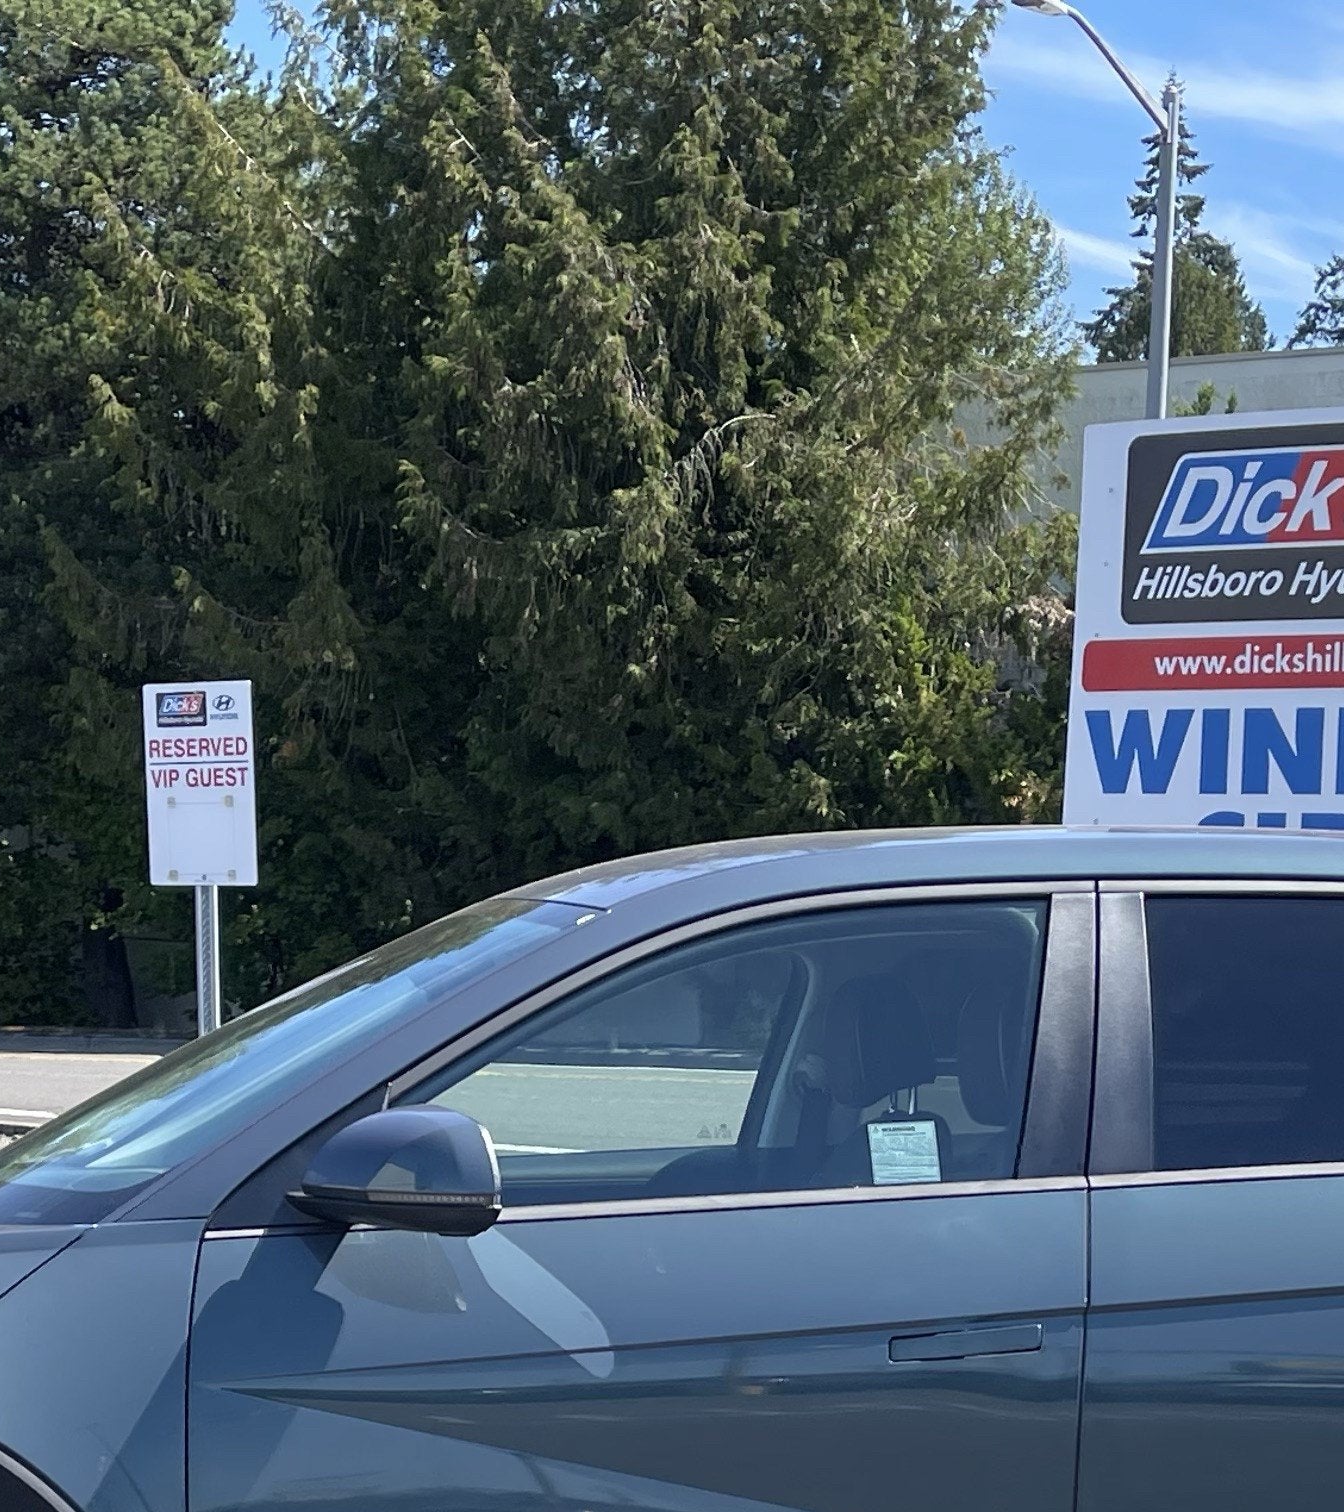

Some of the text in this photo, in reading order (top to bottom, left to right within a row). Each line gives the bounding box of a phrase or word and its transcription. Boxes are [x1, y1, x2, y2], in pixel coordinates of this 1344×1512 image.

[1132, 564, 1284, 601] Hillsboro
[148, 736, 248, 758] RESERVED
[151, 767, 248, 788] VIP GUEST
